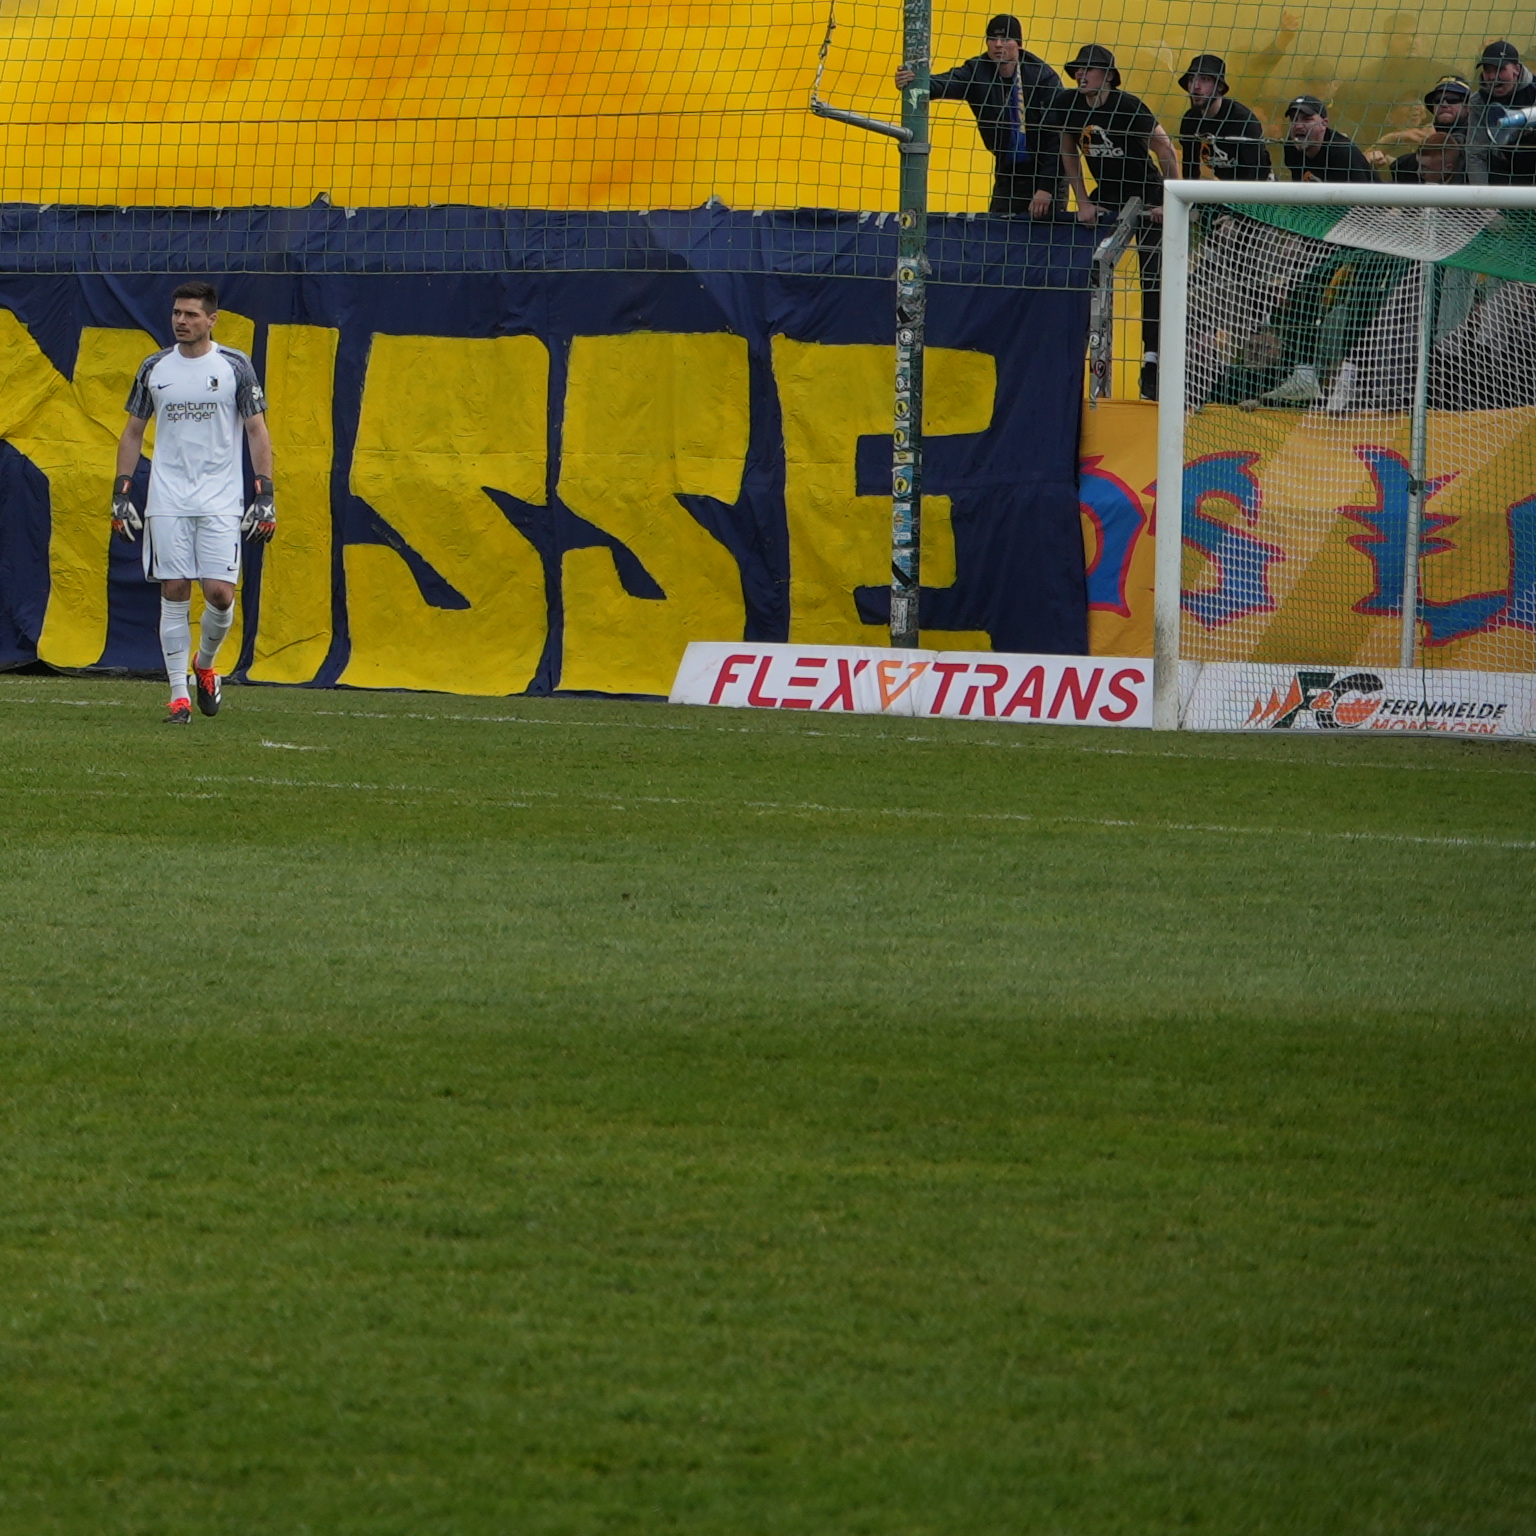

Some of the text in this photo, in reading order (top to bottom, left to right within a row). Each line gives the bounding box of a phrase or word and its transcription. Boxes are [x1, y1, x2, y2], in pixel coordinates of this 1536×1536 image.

[167, 411, 216, 423] springer
[234, 543, 239, 564] 1
[709, 654, 1146, 723] FLEX TRANS
[1379, 699, 1508, 720] FERNMELDE
